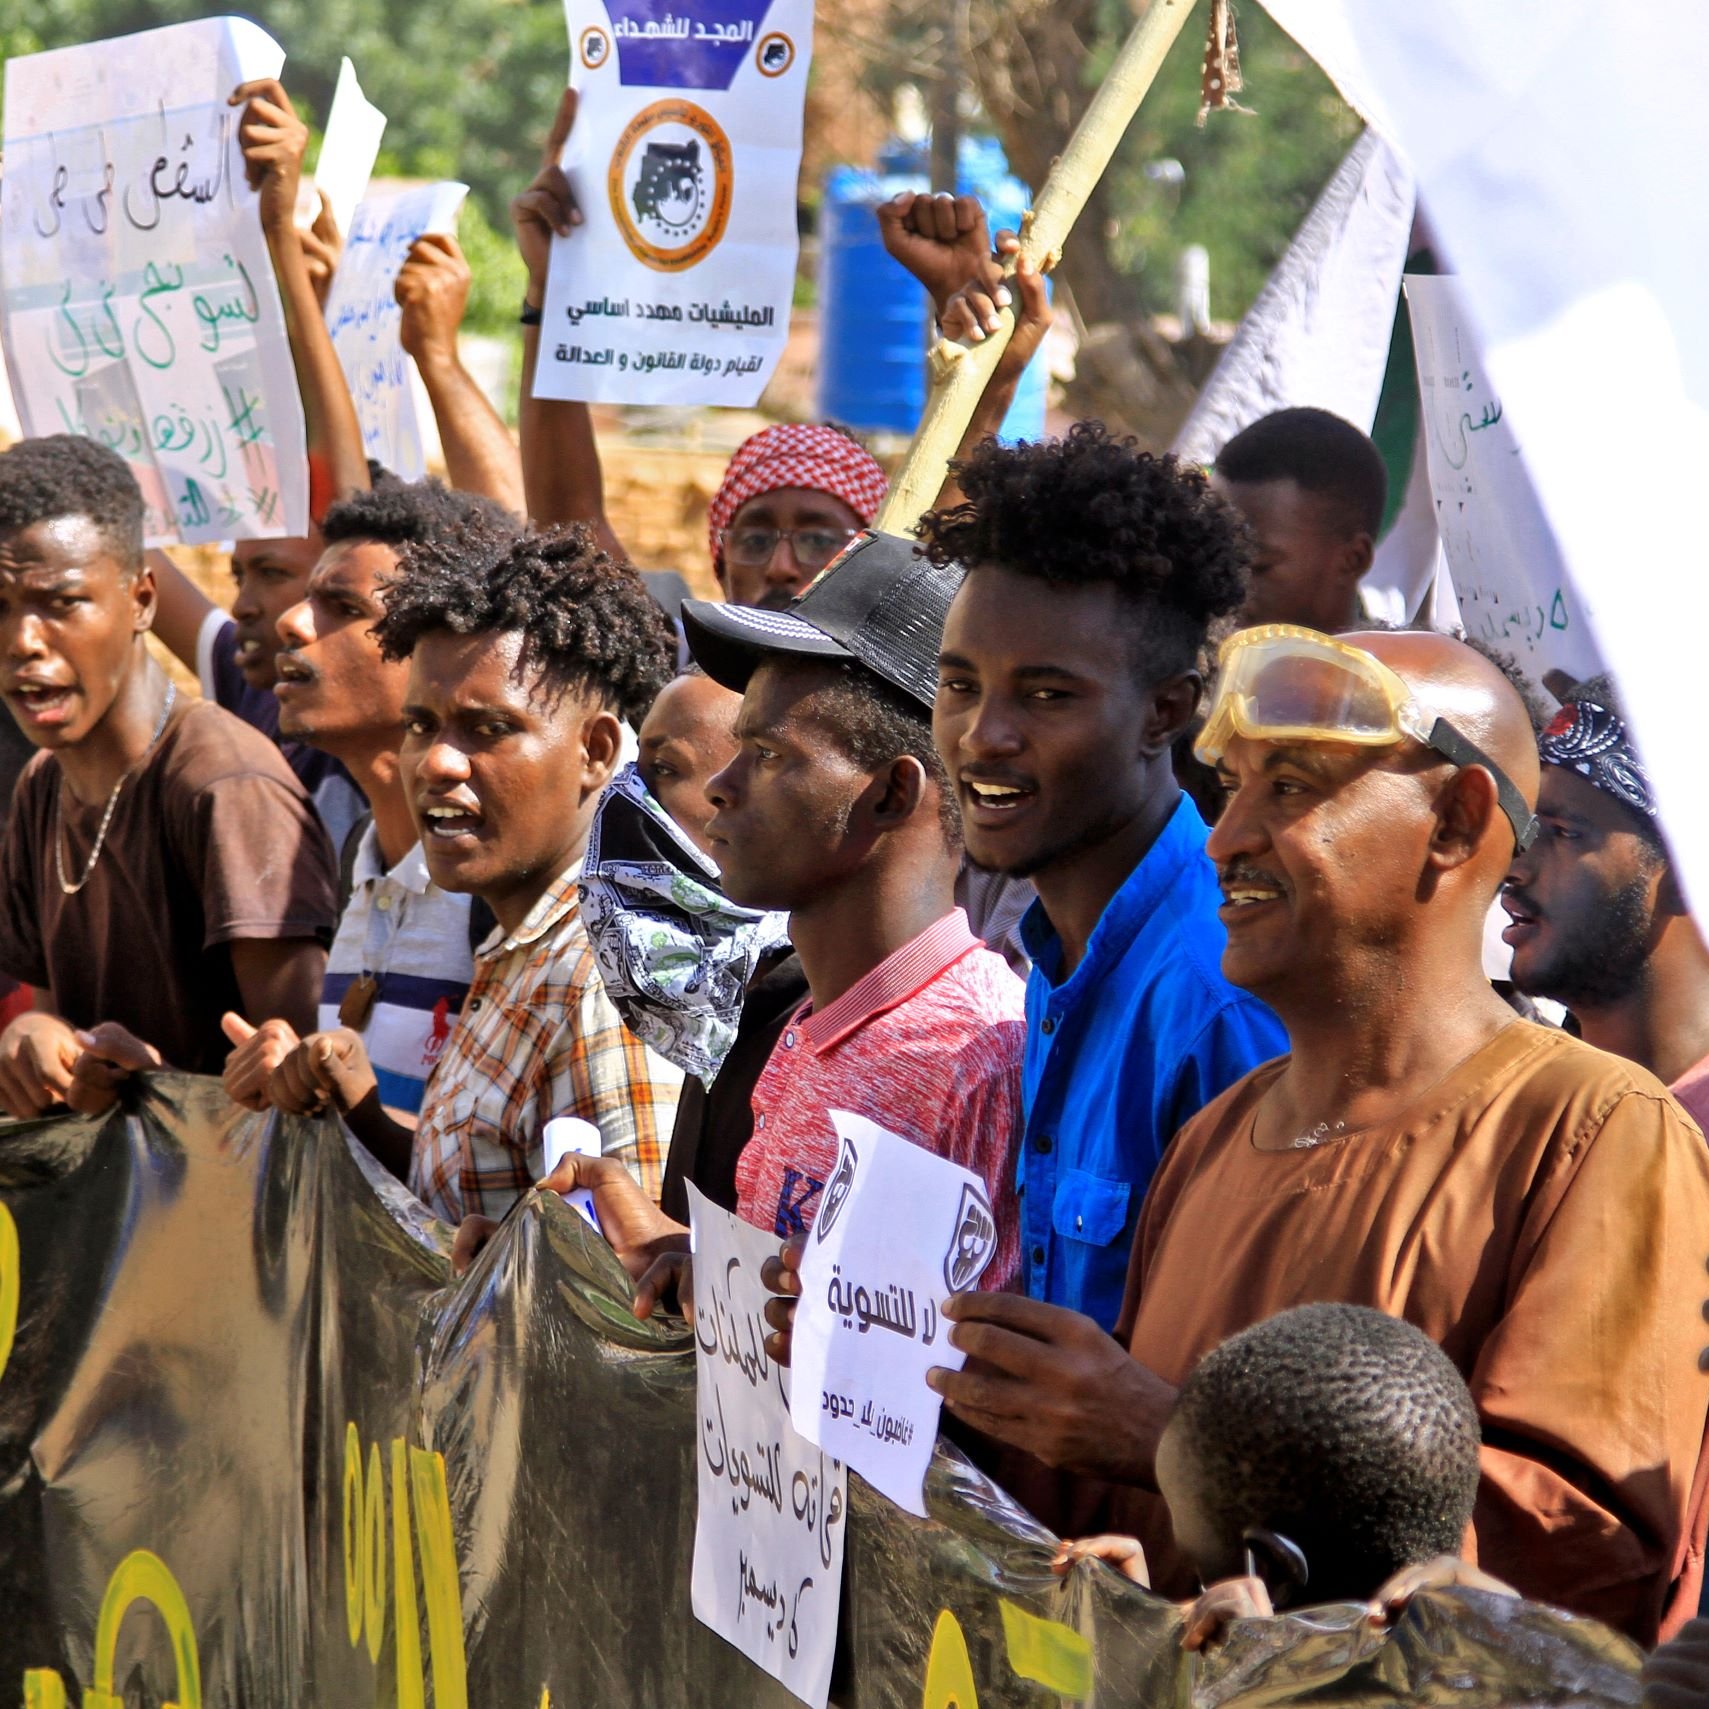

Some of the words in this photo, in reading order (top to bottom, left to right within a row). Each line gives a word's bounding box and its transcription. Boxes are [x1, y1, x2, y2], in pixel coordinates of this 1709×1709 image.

[614, 13, 690, 39] للشهداء
[693, 20, 754, 47] المجد
[567, 297, 630, 326] اساسي
[636, 303, 684, 322] مهدد
[688, 300, 774, 330] المليشيات
[555, 343, 615, 366] العدالة
[618, 349, 629, 370] و
[632, 350, 687, 373] القانون
[690, 351, 721, 377] دولة
[721, 355, 763, 378] لقيام
[827, 1263, 916, 1341] للتسوية
[921, 1297, 938, 1347] لا
[702, 1383, 783, 1516] للتسويات
